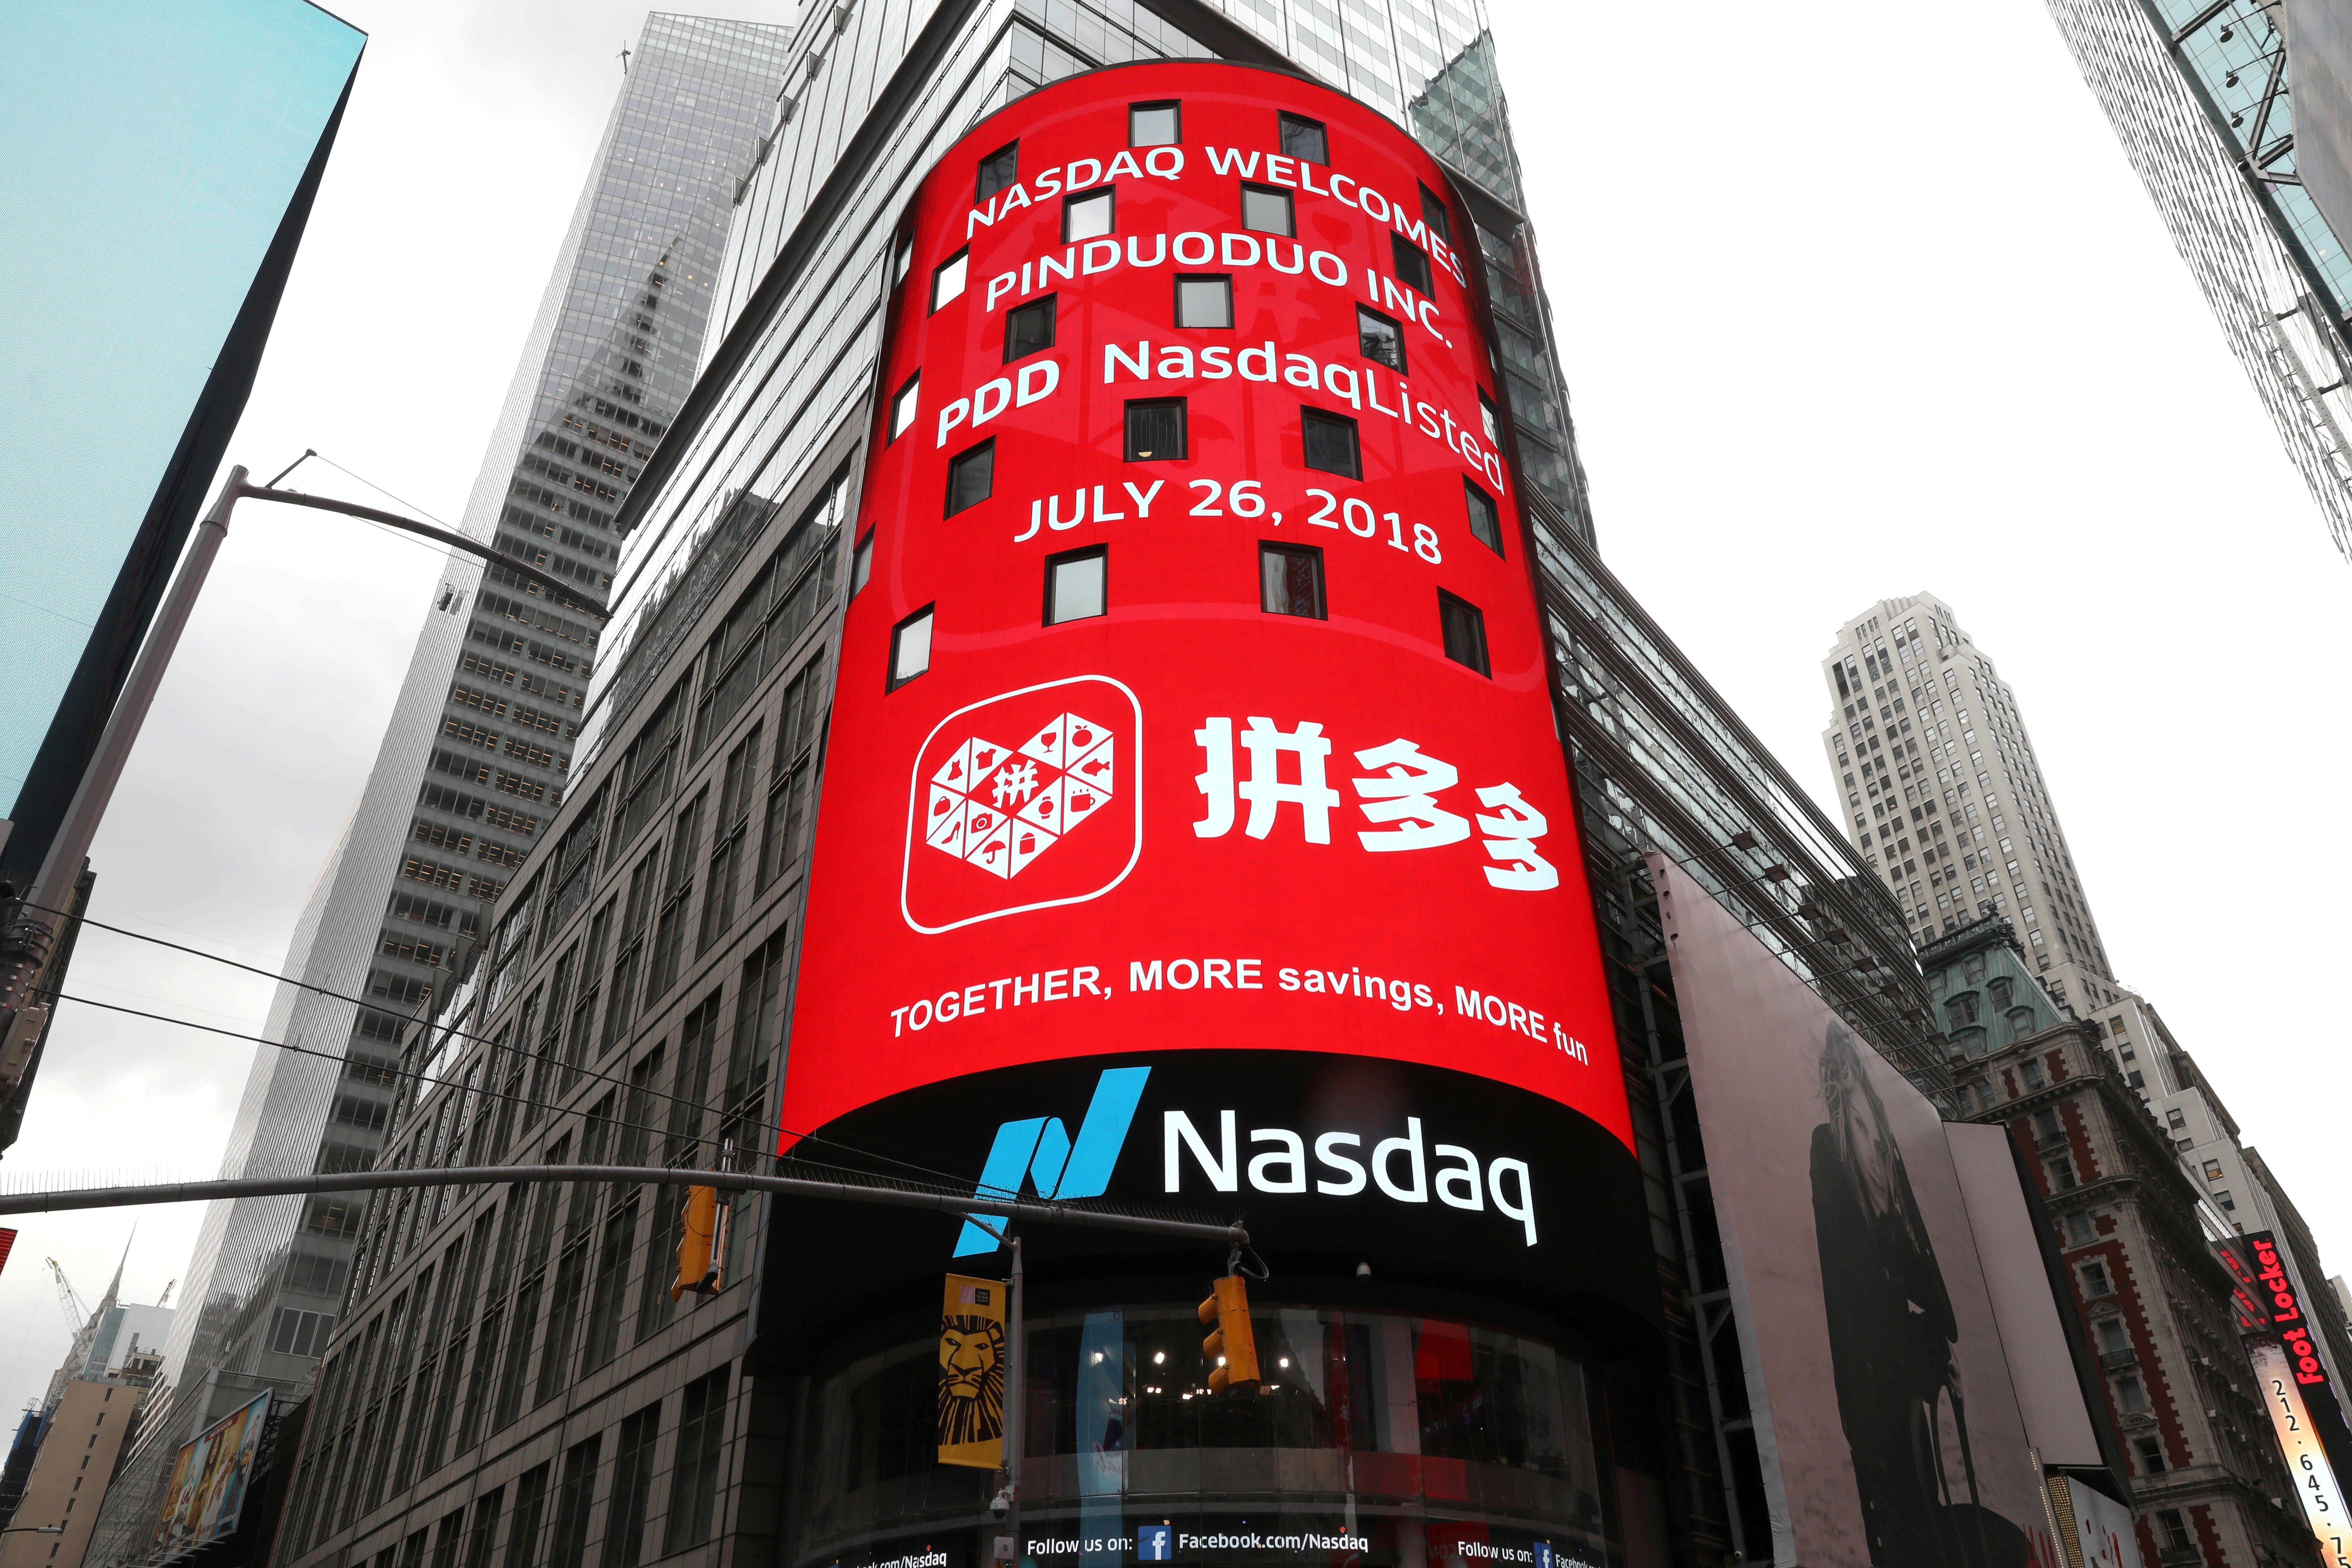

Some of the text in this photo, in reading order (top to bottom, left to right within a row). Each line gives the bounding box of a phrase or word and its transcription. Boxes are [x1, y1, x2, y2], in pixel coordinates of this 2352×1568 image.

[966, 146, 1467, 289] NASDAQ WELCOMES
[986, 232, 1453, 349] PINDUODUO INC.
[936, 340, 1505, 496] PDD NasdaqListed
[1014, 479, 1442, 564] JULY 26, 2018
[991, 759, 1039, 809] 拼
[1192, 716, 1559, 891] 拼多多
[891, 959, 1588, 1066] TOGETHER, MORE savings, MORE fun
[1164, 1110, 1537, 1247] Nasdaq
[2253, 1240, 2324, 1384] Foot Locker
[1027, 1538, 1079, 1555] Follow
[1085, 1539, 1102, 1552] us
[1107, 1538, 1132, 1551] on:
[1179, 1533, 1368, 1553] Facebook.com/Nasdaq
[1458, 1541, 1498, 1559] Follow
[1502, 1548, 1514, 1560] us
[1517, 1550, 1533, 1563] on:
